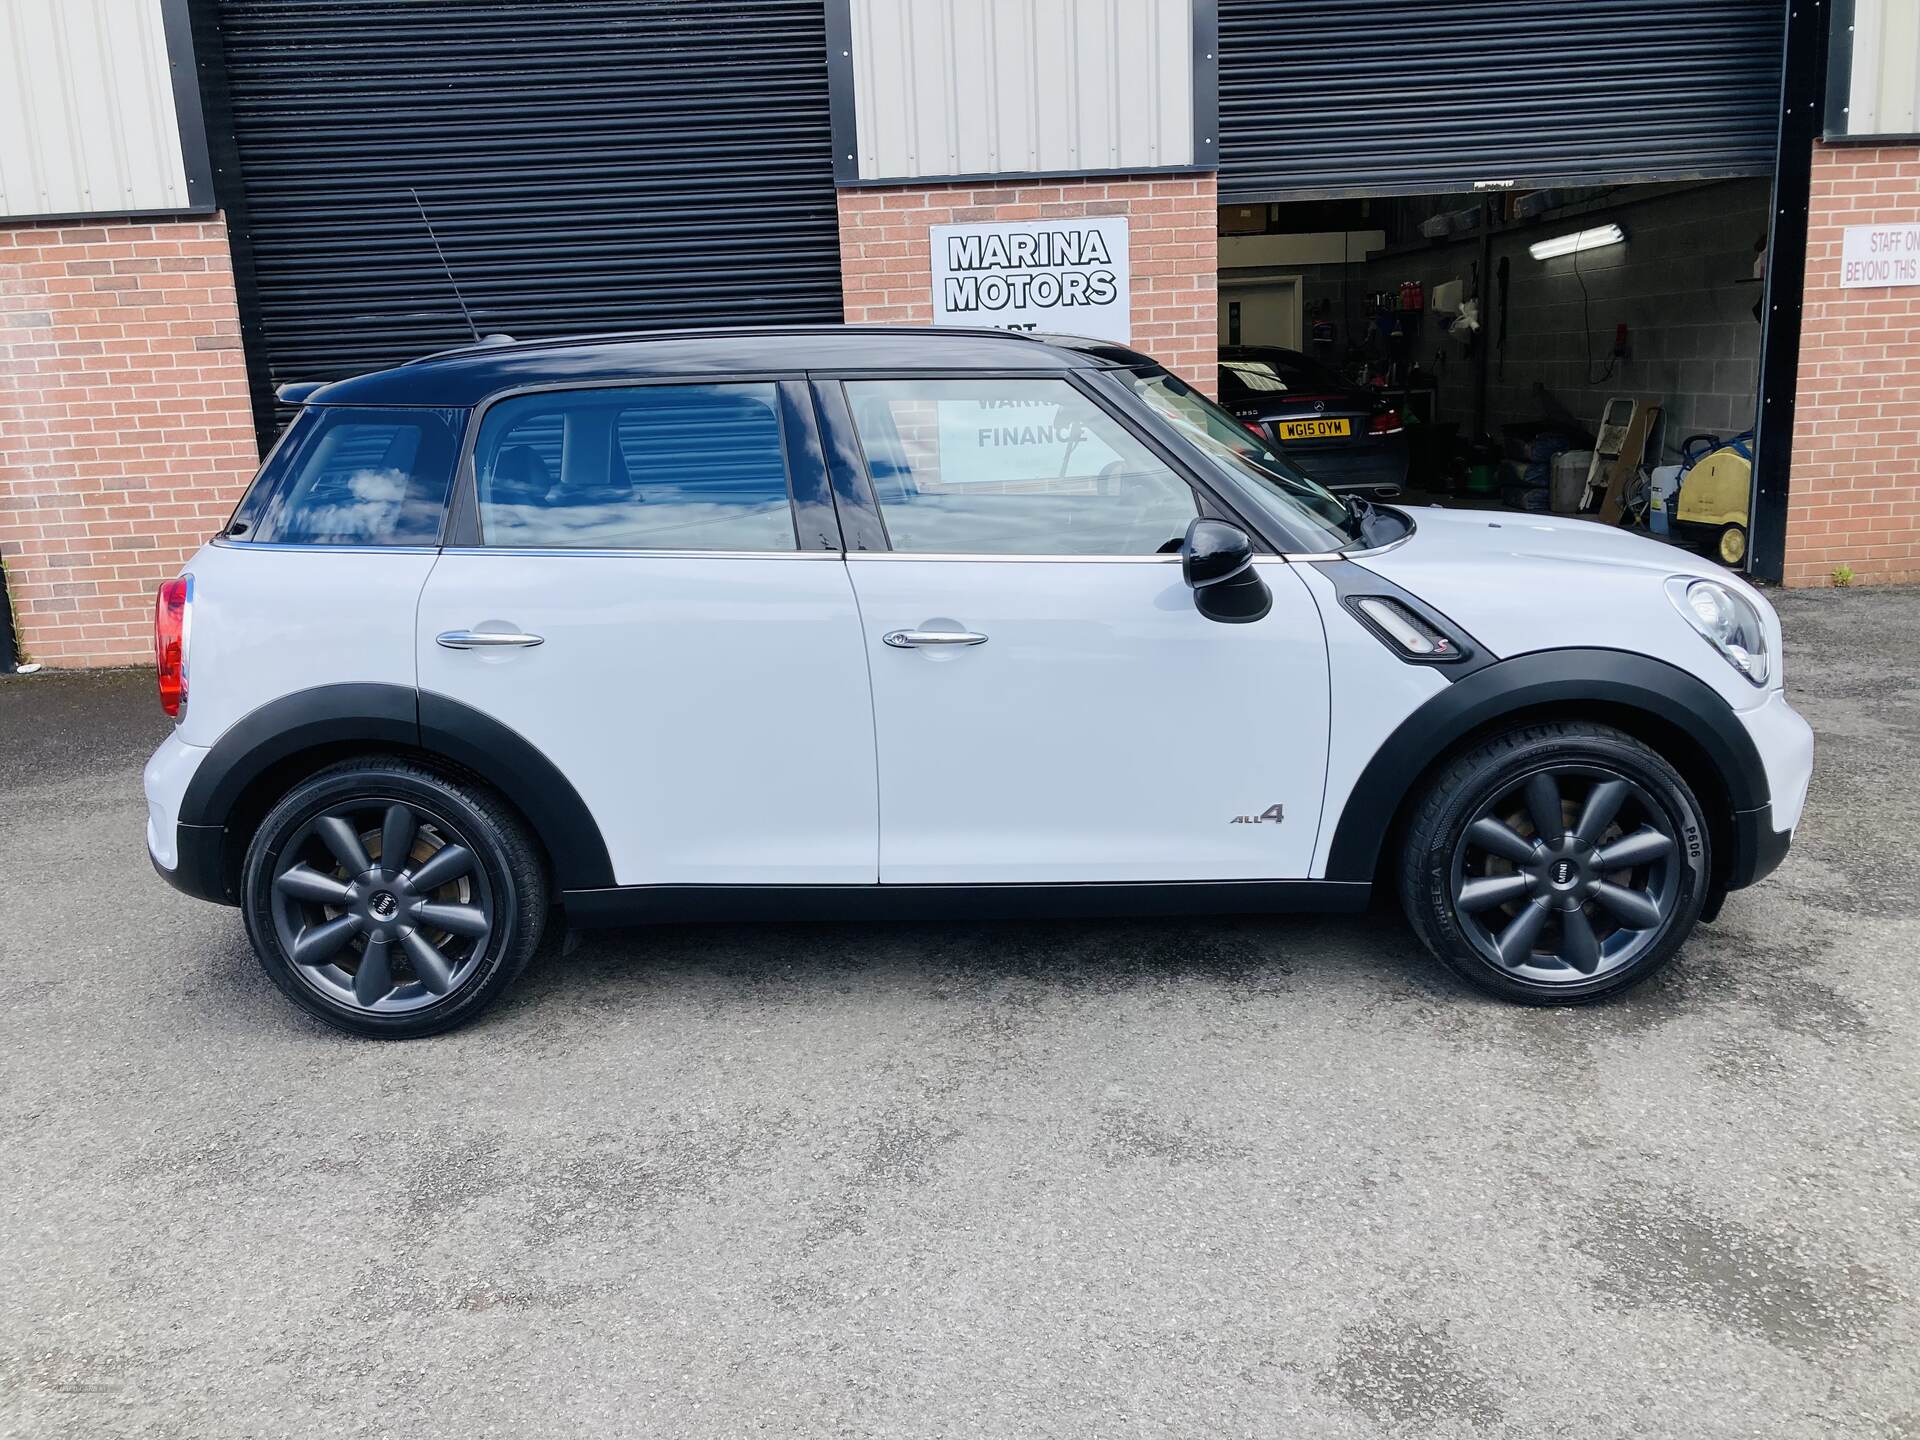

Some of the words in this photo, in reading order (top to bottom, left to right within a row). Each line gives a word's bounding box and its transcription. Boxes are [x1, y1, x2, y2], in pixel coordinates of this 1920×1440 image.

[947, 230, 1112, 271] MARINA
[1871, 231, 1902, 252] STAFF
[1846, 260, 1890, 282] BEYOND
[1894, 259, 1917, 280] THIS
[945, 270, 1117, 312] MOTORS
[1287, 423, 1315, 437] WG15
[1318, 421, 1342, 434] OYM
[1685, 826, 1701, 857] P606
[1558, 864, 1568, 882] MINI
[378, 896, 391, 913] MINI
